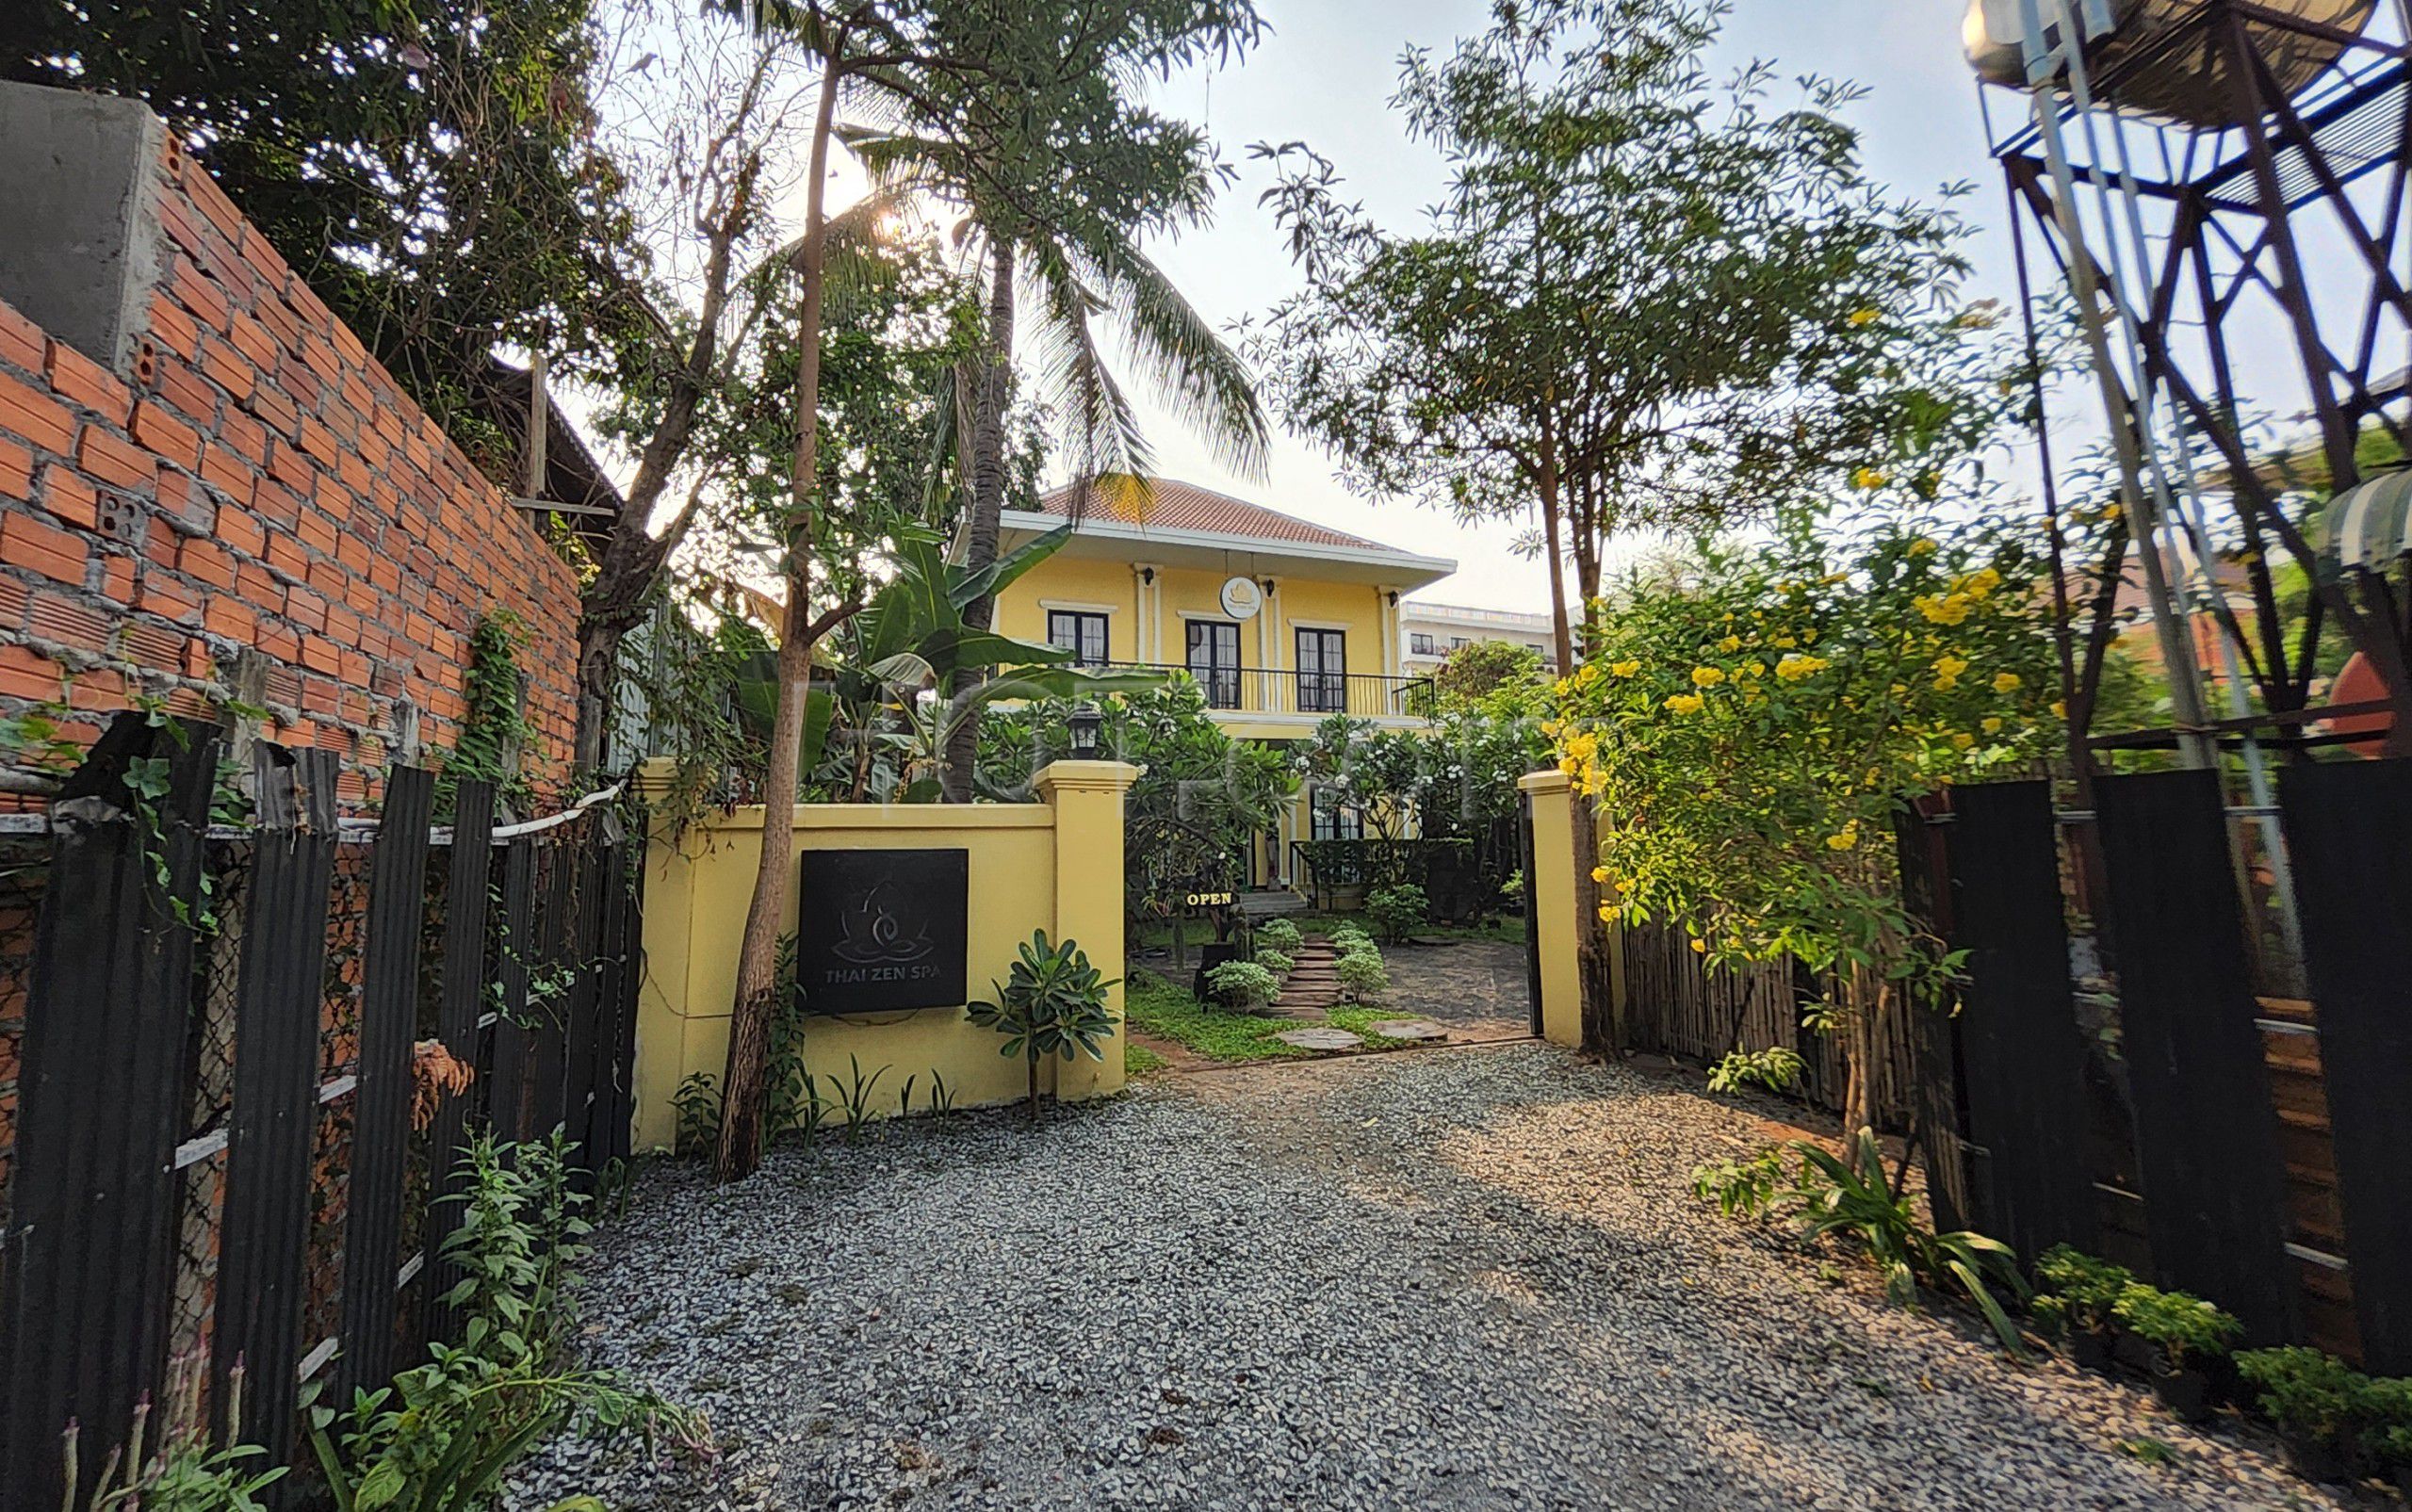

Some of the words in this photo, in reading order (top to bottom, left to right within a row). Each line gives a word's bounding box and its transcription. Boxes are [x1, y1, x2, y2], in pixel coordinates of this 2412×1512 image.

[1187, 893, 1231, 905] OPEN
[826, 969, 866, 984] THAI
[872, 967, 905, 981] ZEN
[911, 966, 941, 980] SPA
